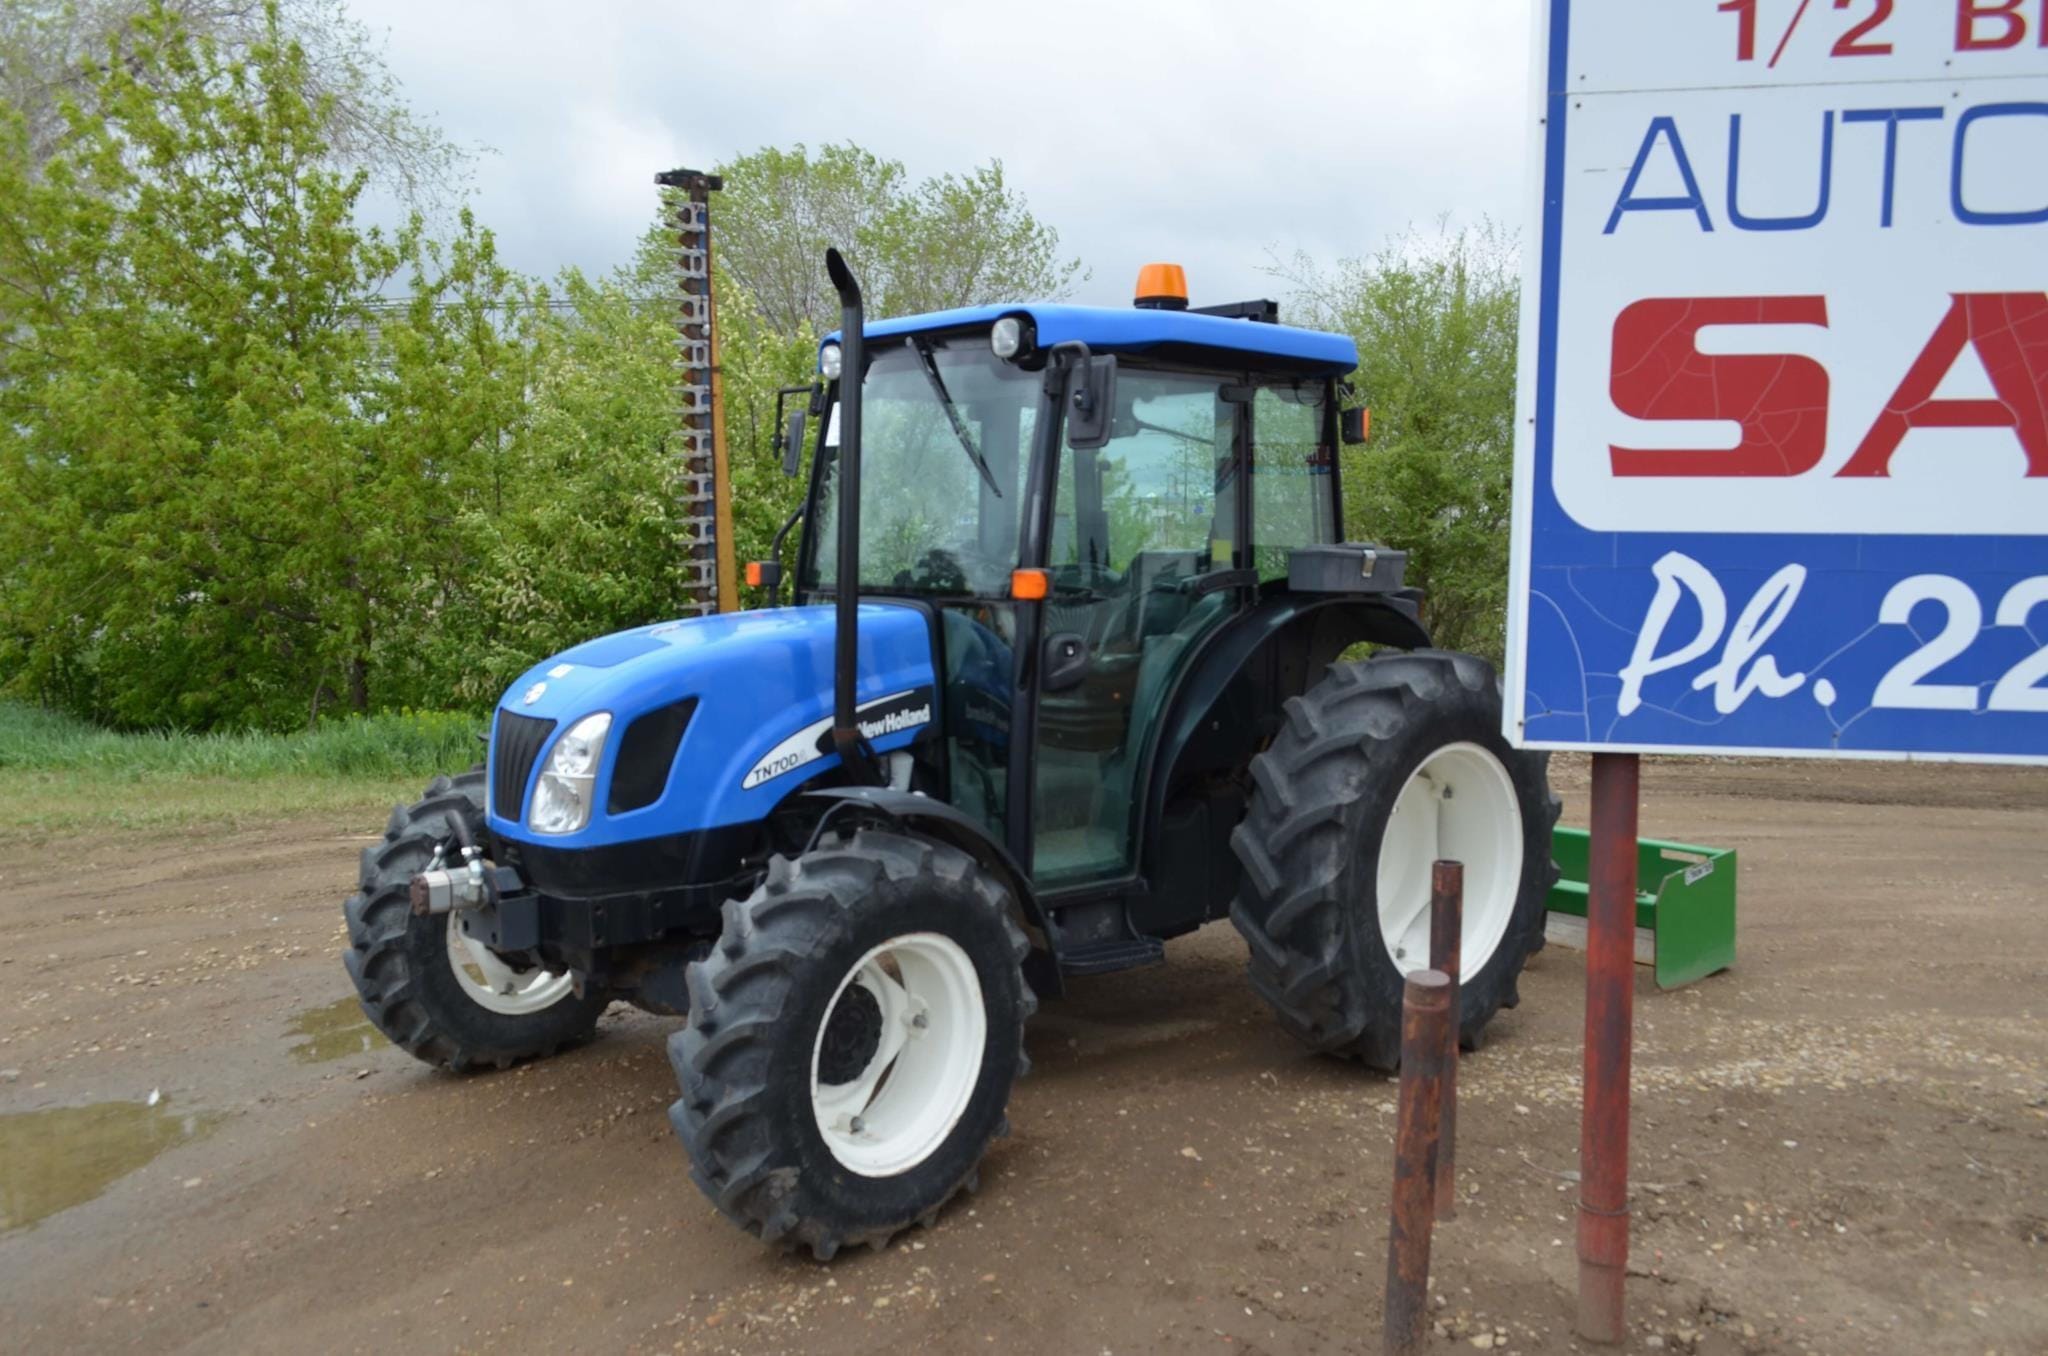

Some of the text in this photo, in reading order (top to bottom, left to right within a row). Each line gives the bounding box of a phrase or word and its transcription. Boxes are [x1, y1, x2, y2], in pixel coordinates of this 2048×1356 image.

[1717, 0, 2048, 68] 1/2 B
[1602, 101, 2048, 235] AUTO
[1609, 291, 2048, 477] SA
[1619, 551, 1837, 716] Ph.
